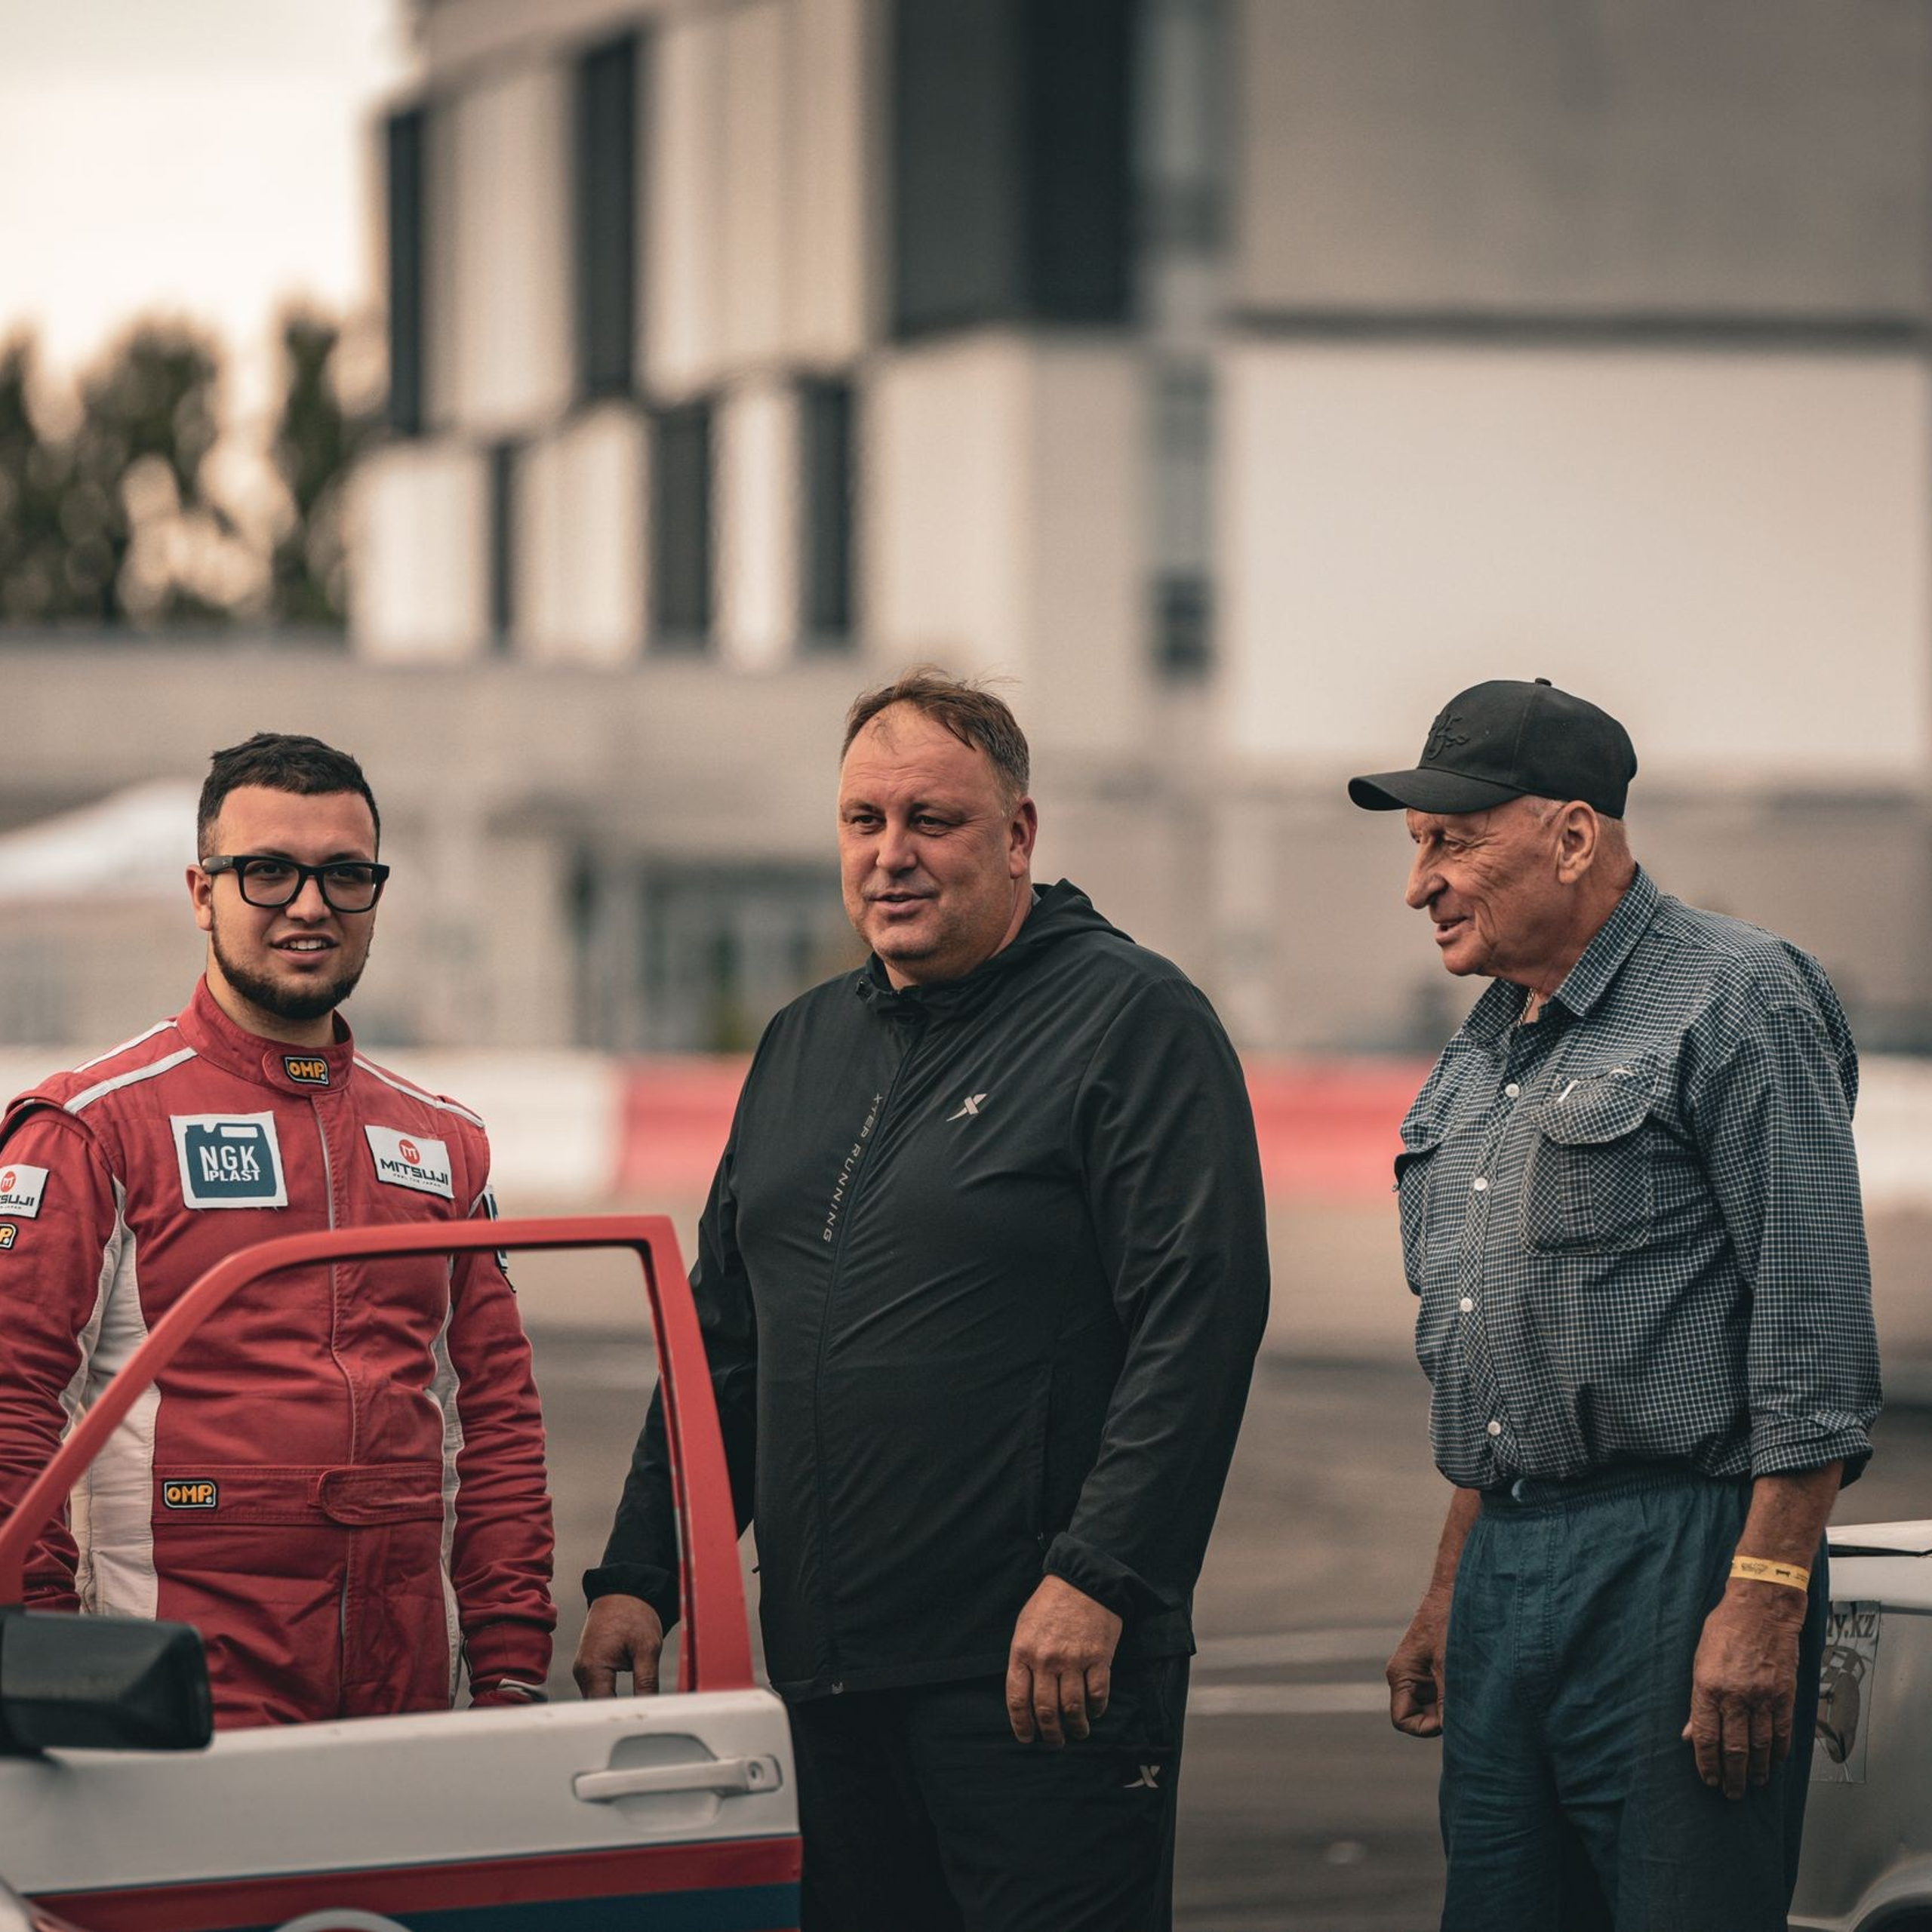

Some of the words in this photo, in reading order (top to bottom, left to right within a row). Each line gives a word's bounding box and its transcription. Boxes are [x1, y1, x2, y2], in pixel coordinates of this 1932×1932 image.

[289, 1061, 325, 1078] OMP
[860, 1094, 884, 1138] XTEP
[199, 1145, 260, 1171] NGK
[208, 1170, 260, 1182] PLAST
[380, 1158, 449, 1186] MITSUJI
[0, 1195, 35, 1207] SUJI
[823, 1143, 862, 1243] RUNNING
[167, 1484, 212, 1503] OMP
